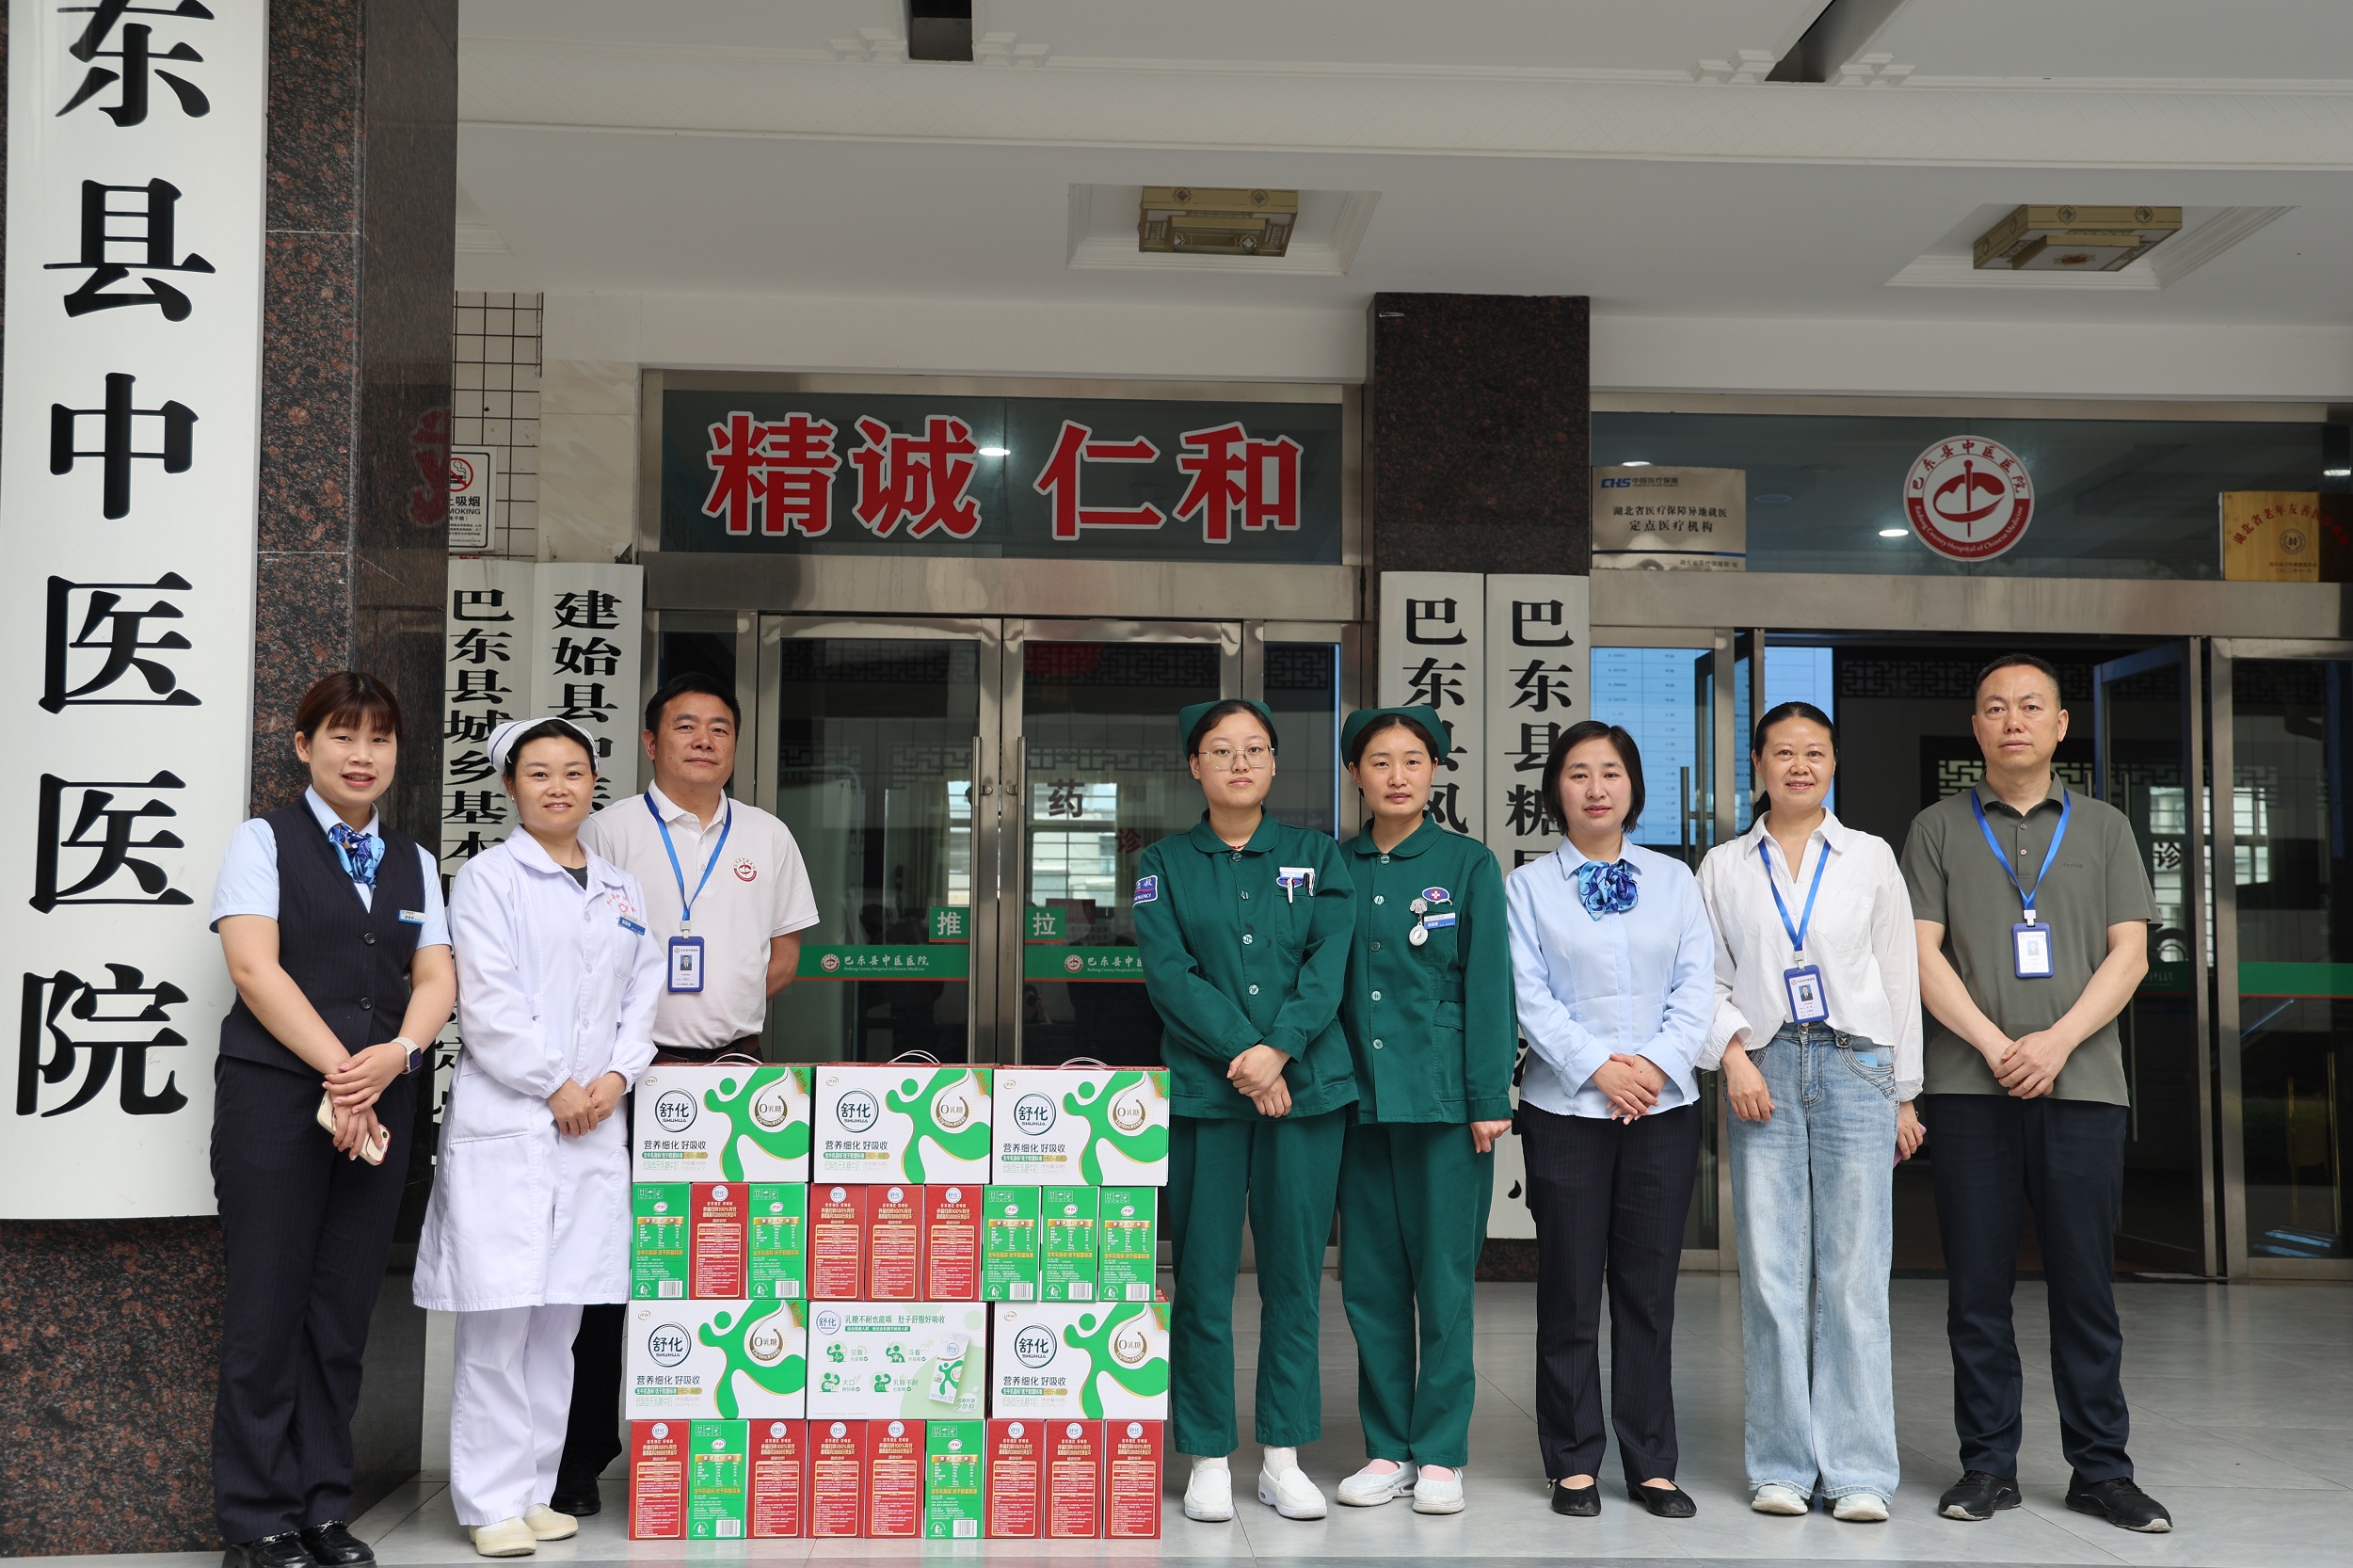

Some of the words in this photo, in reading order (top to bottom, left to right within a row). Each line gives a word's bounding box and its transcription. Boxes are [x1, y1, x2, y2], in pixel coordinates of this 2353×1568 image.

[702, 410, 983, 538] 精诚
[1033, 419, 1305, 543] 仁和
[1613, 504, 1728, 518] 湖北省医疗保障异地就医
[1629, 520, 1713, 533] 定点医疗机构
[1947, 541, 1977, 553] Hospital
[1984, 532, 2009, 550] Chinese
[16, 0, 216, 1118] 东县中医医院
[1504, 600, 1575, 875] 巴东县糖
[1048, 778, 1084, 818] 药
[1115, 827, 1142, 855] 诊
[937, 911, 961, 936] 推
[1032, 912, 1055, 936] 拉
[844, 953, 929, 967] 巴东县中医医院
[660, 1103, 689, 1118] 舒化
[841, 1103, 871, 1118] 舒化
[1018, 1106, 1048, 1122] 舒化
[644, 1141, 680, 1150] 营养细化
[681, 1141, 707, 1150] 好吸收
[825, 1141, 861, 1150] 营养细化
[863, 1141, 888, 1150] 好吸收
[1003, 1143, 1039, 1153] 营养细化
[1041, 1143, 1065, 1153] 好吸收
[819, 1318, 836, 1327] 舒化
[845, 1315, 892, 1323] 乳糖不耐也能喝
[898, 1315, 945, 1323] 肚子舒服好吸收
[653, 1336, 683, 1352] 舒化
[1018, 1337, 1048, 1353] 舒化
[636, 1375, 672, 1385] 营养细化
[675, 1375, 700, 1385] 好吸收
[1003, 1376, 1039, 1386] 营养细化
[1041, 1376, 1065, 1386] 好吸收
